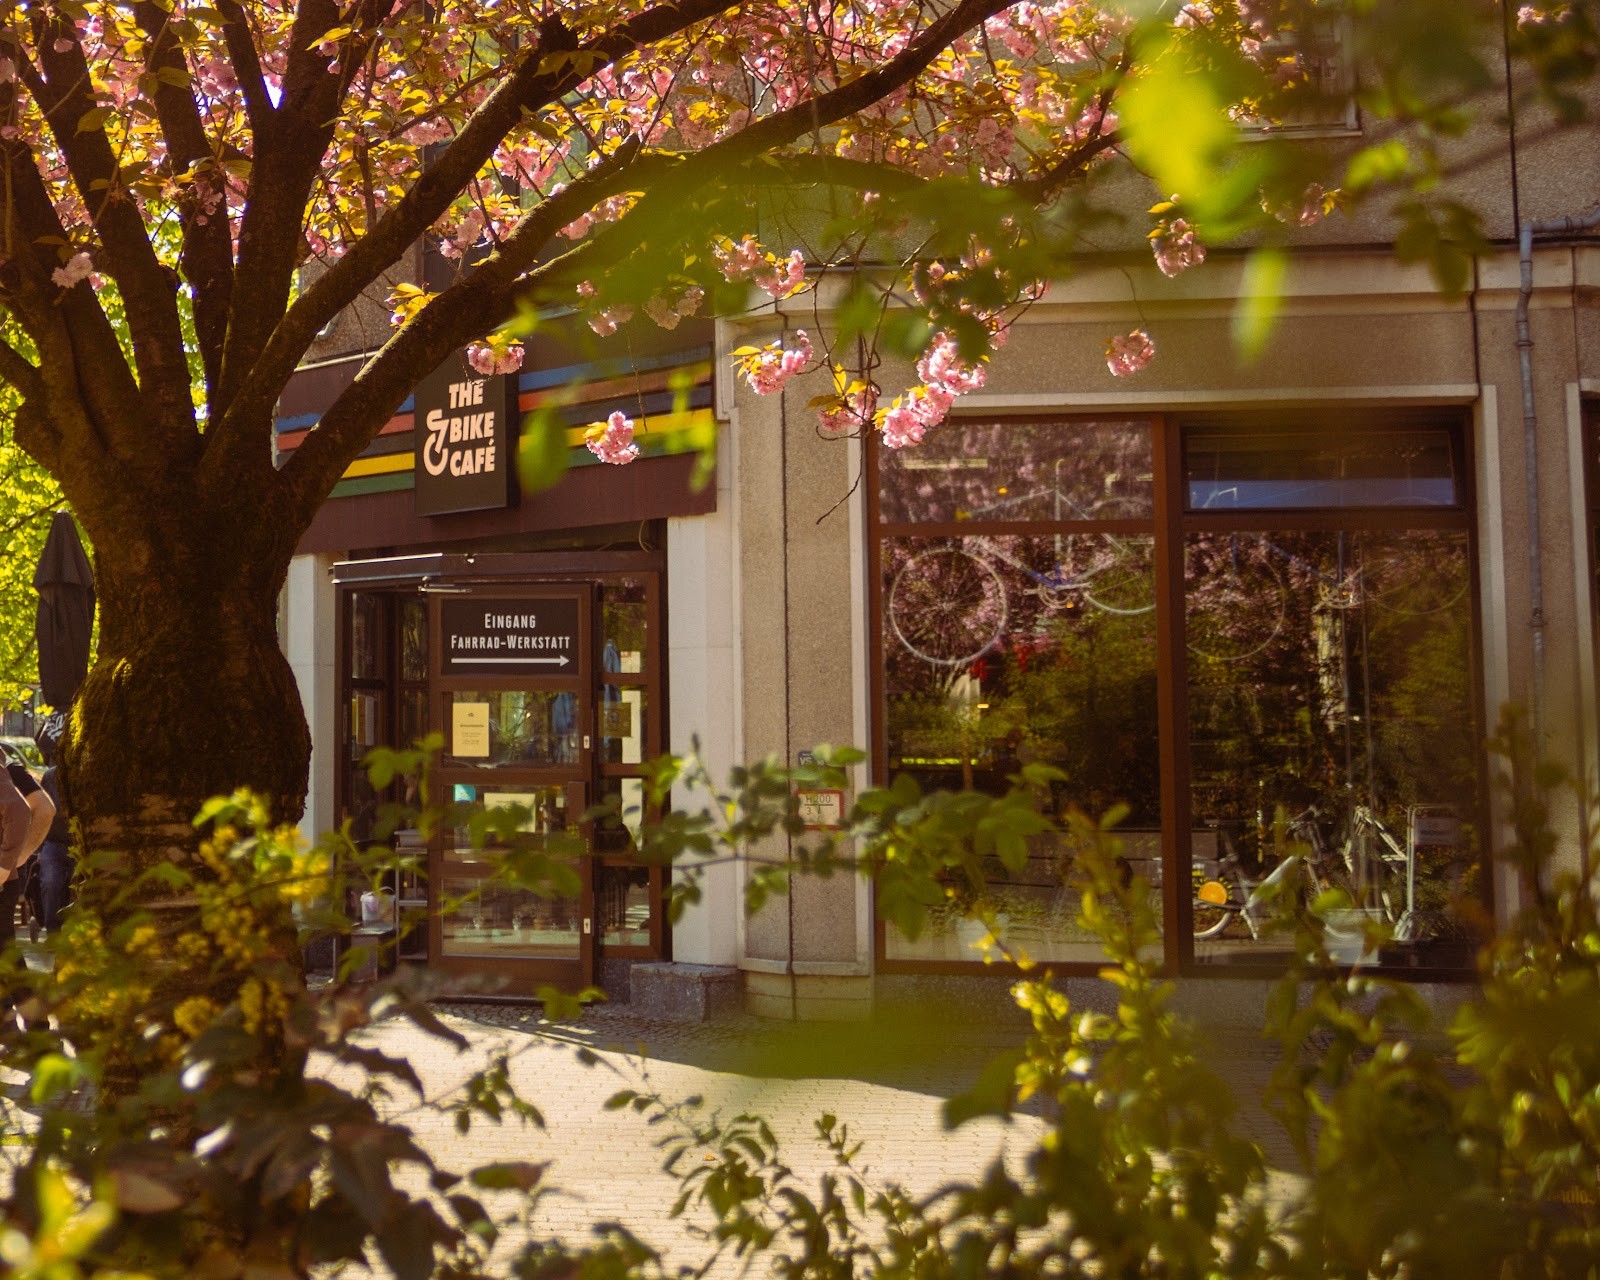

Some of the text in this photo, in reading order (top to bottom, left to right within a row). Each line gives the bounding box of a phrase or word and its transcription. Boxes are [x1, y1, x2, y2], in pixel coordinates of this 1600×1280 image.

[448, 379, 484, 409] THE
[449, 411, 495, 443] BIKE
[449, 438, 496, 477] CAFÉ
